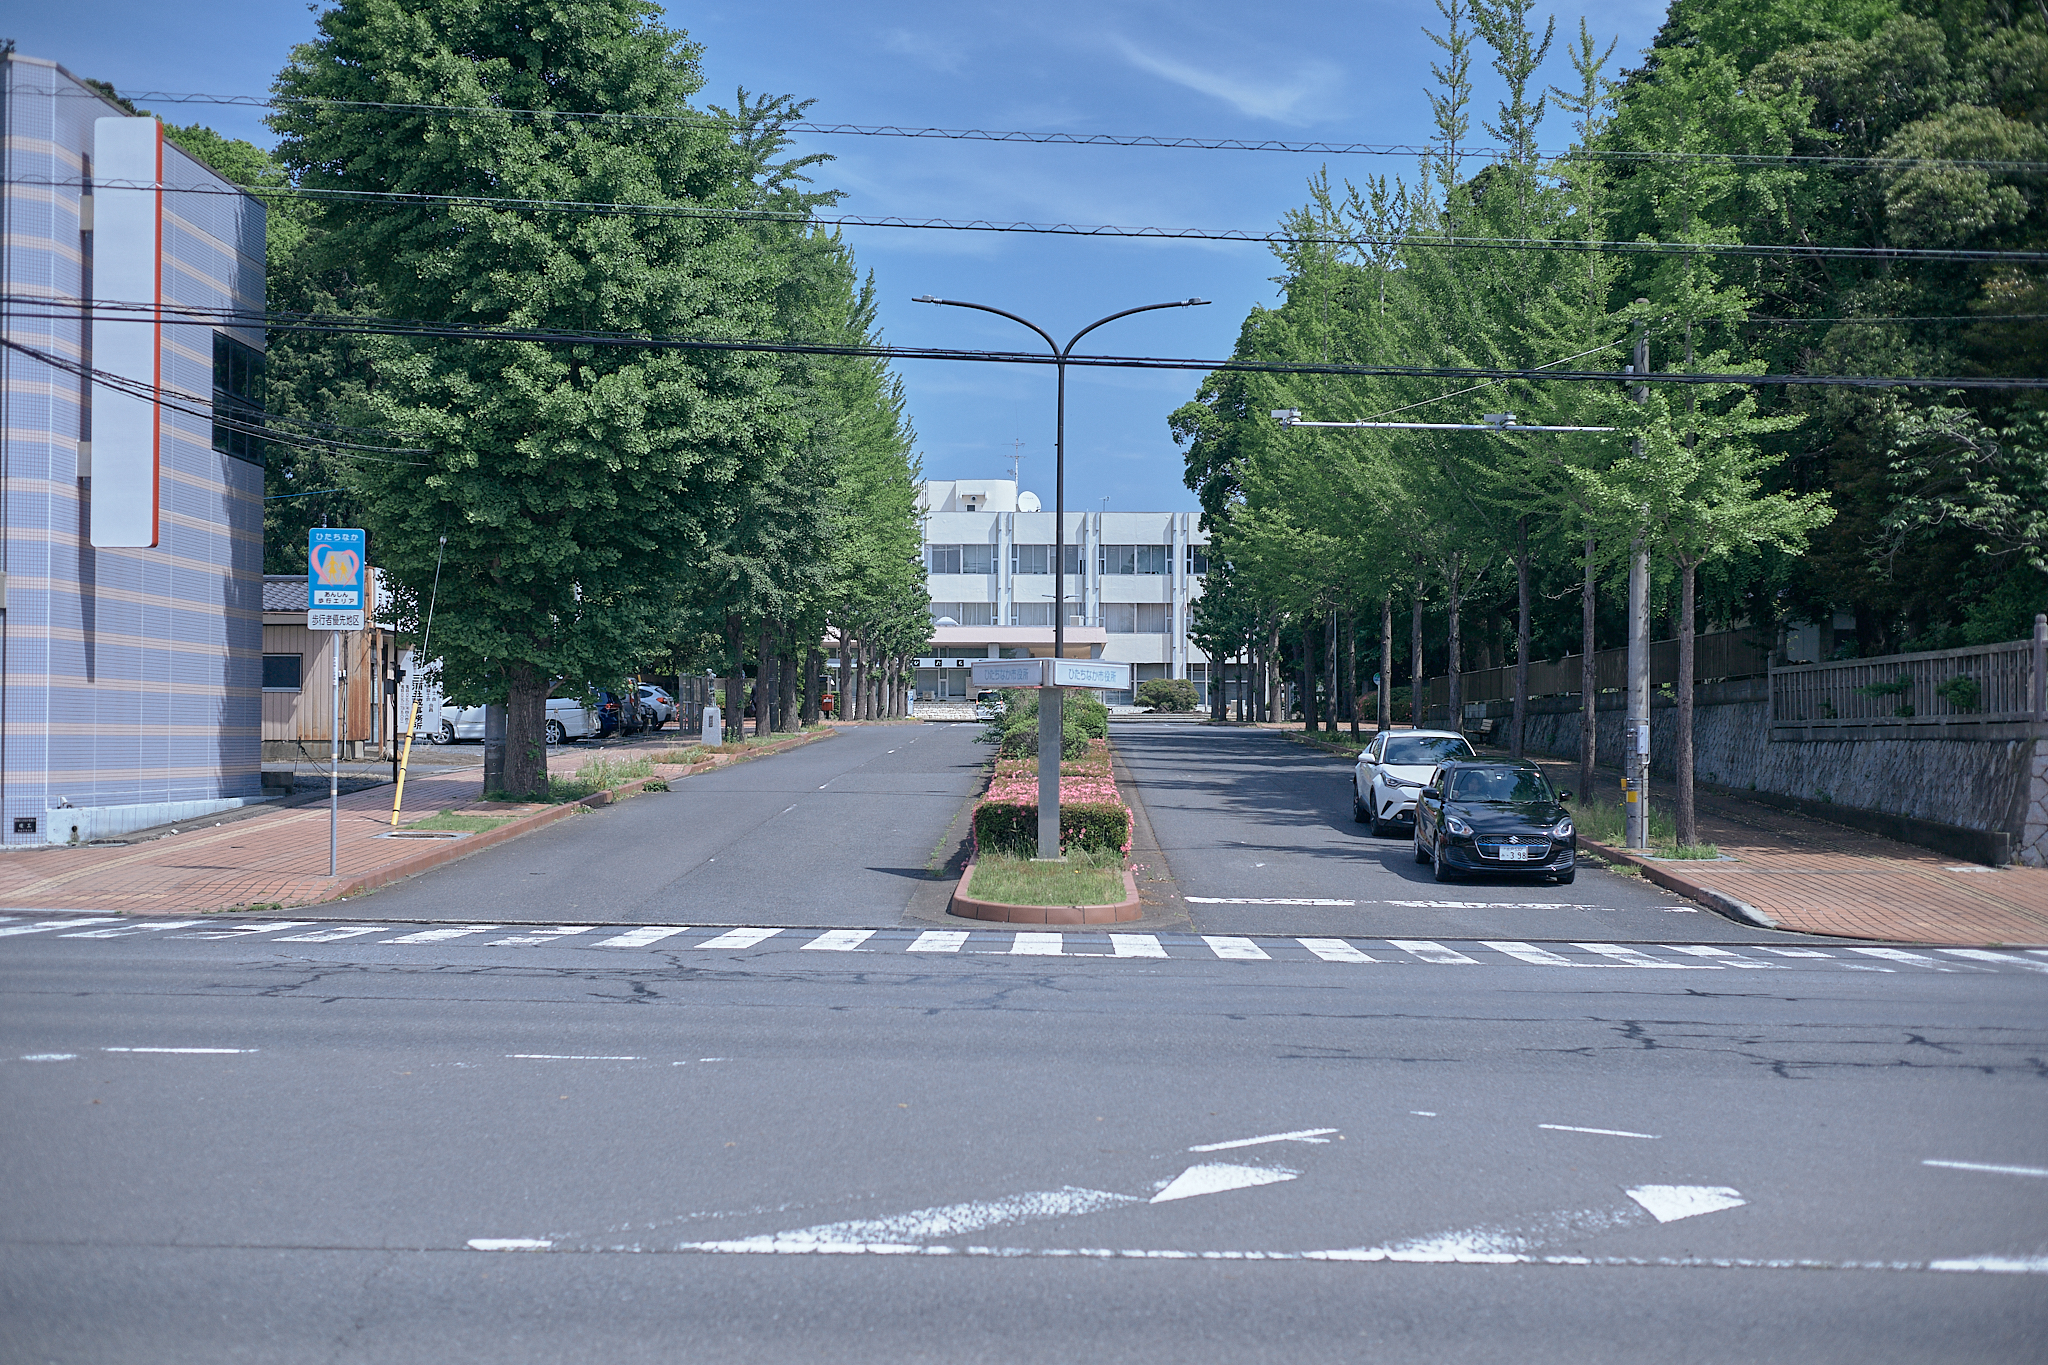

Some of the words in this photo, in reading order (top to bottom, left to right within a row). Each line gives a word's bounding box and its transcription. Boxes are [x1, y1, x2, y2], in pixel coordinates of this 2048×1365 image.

[315, 533, 359, 541] ひたちなか
[312, 614, 359, 626] 歩行者優先地区
[984, 668, 1029, 681] ひたちなか市役所
[1068, 668, 1117, 683] ひたちなか市役所
